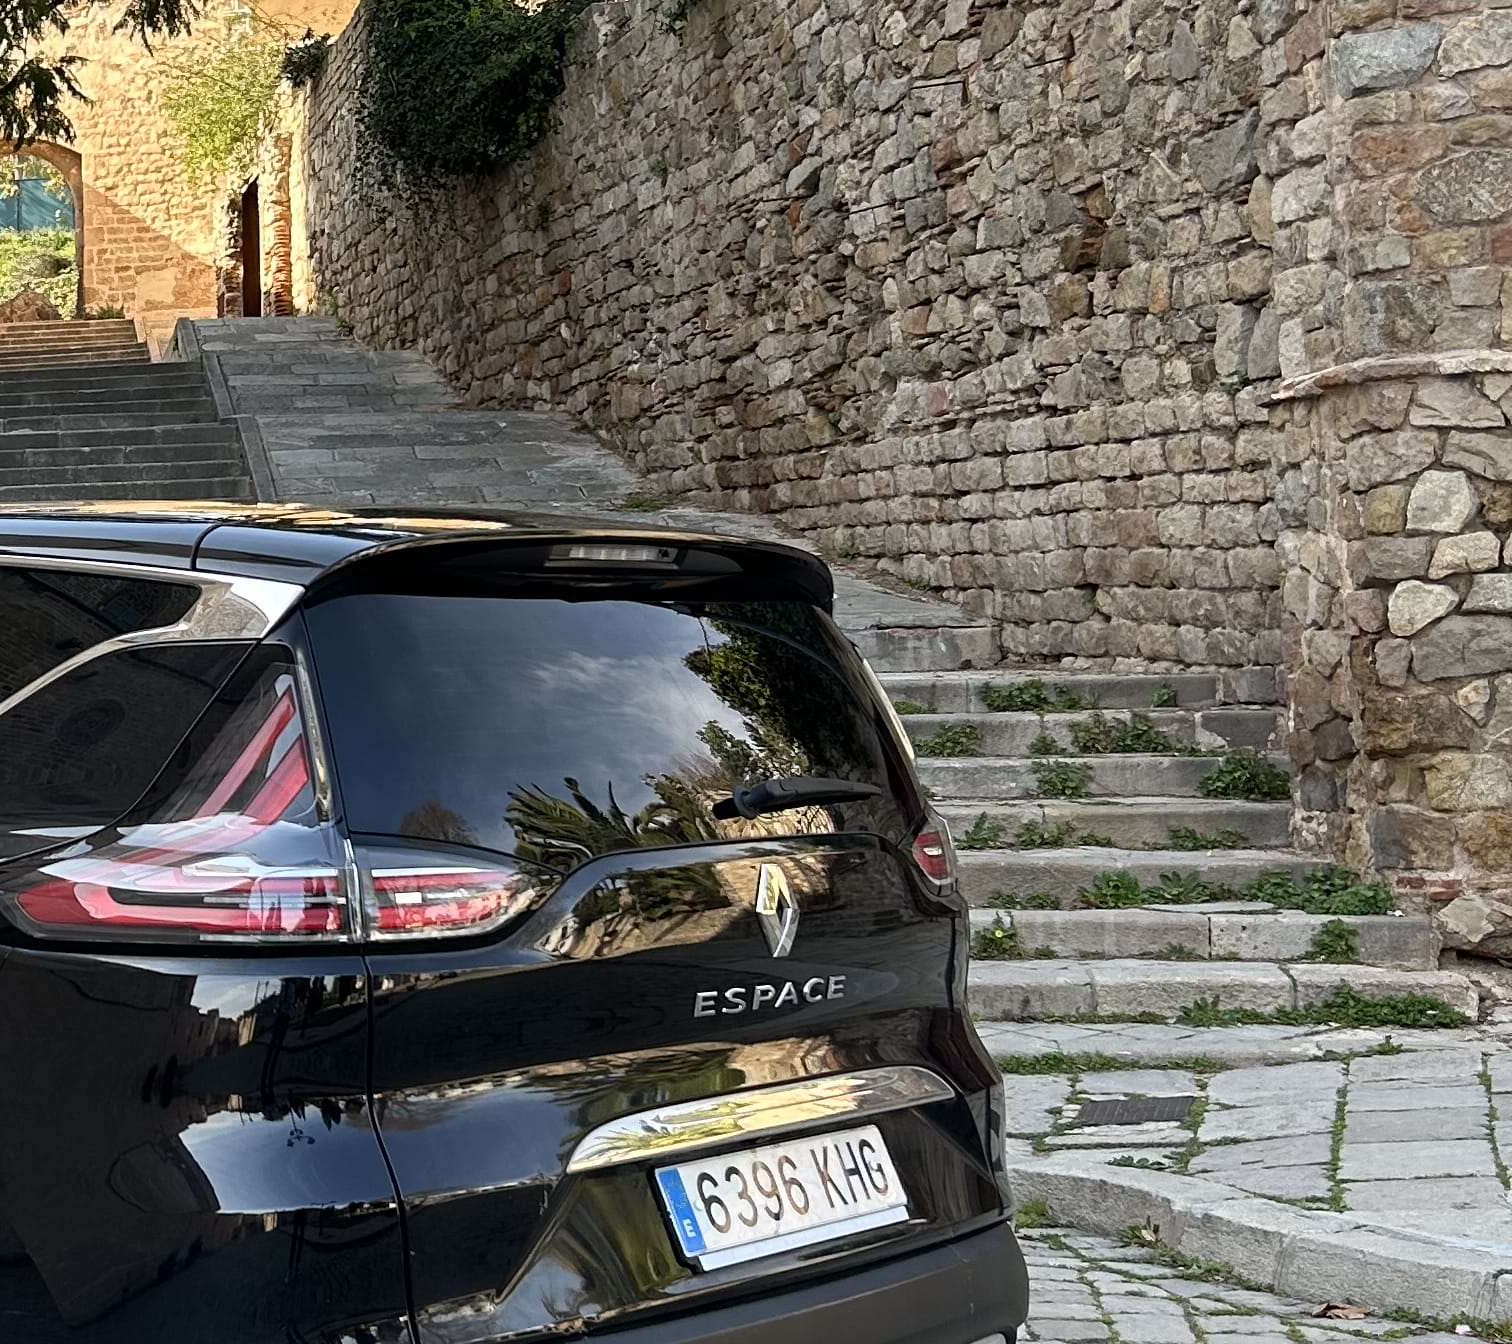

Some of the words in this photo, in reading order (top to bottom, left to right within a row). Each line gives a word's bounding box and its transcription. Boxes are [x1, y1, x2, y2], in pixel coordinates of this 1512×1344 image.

[693, 975, 846, 1018] ESPACE
[696, 1155, 810, 1234] 6396
[809, 1138, 889, 1208] KHG
